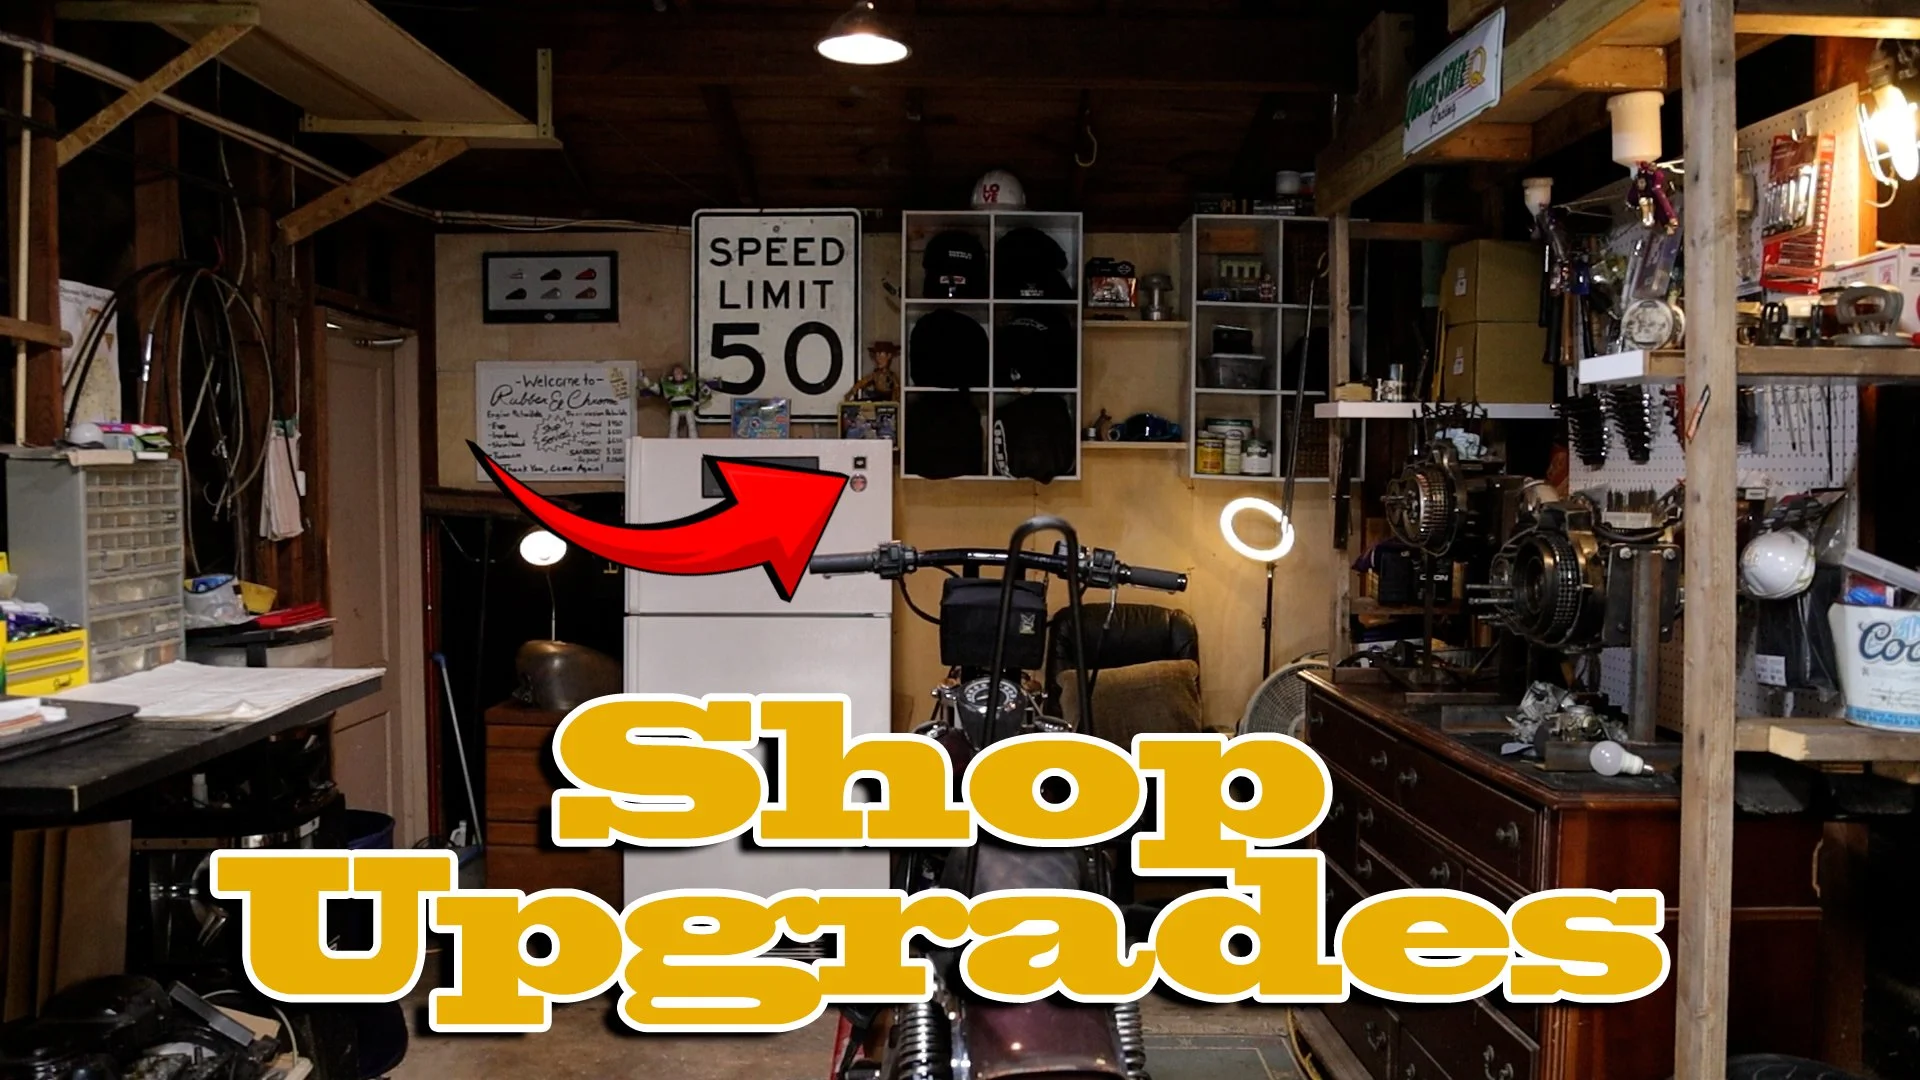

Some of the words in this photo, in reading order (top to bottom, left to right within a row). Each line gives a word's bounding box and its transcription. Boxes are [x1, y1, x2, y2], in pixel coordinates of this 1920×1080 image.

[709, 237, 845, 267] SPEED
[719, 280, 834, 309] LIMIT
[711, 321, 843, 395] 50
[490, 384, 548, 407] Rubber
